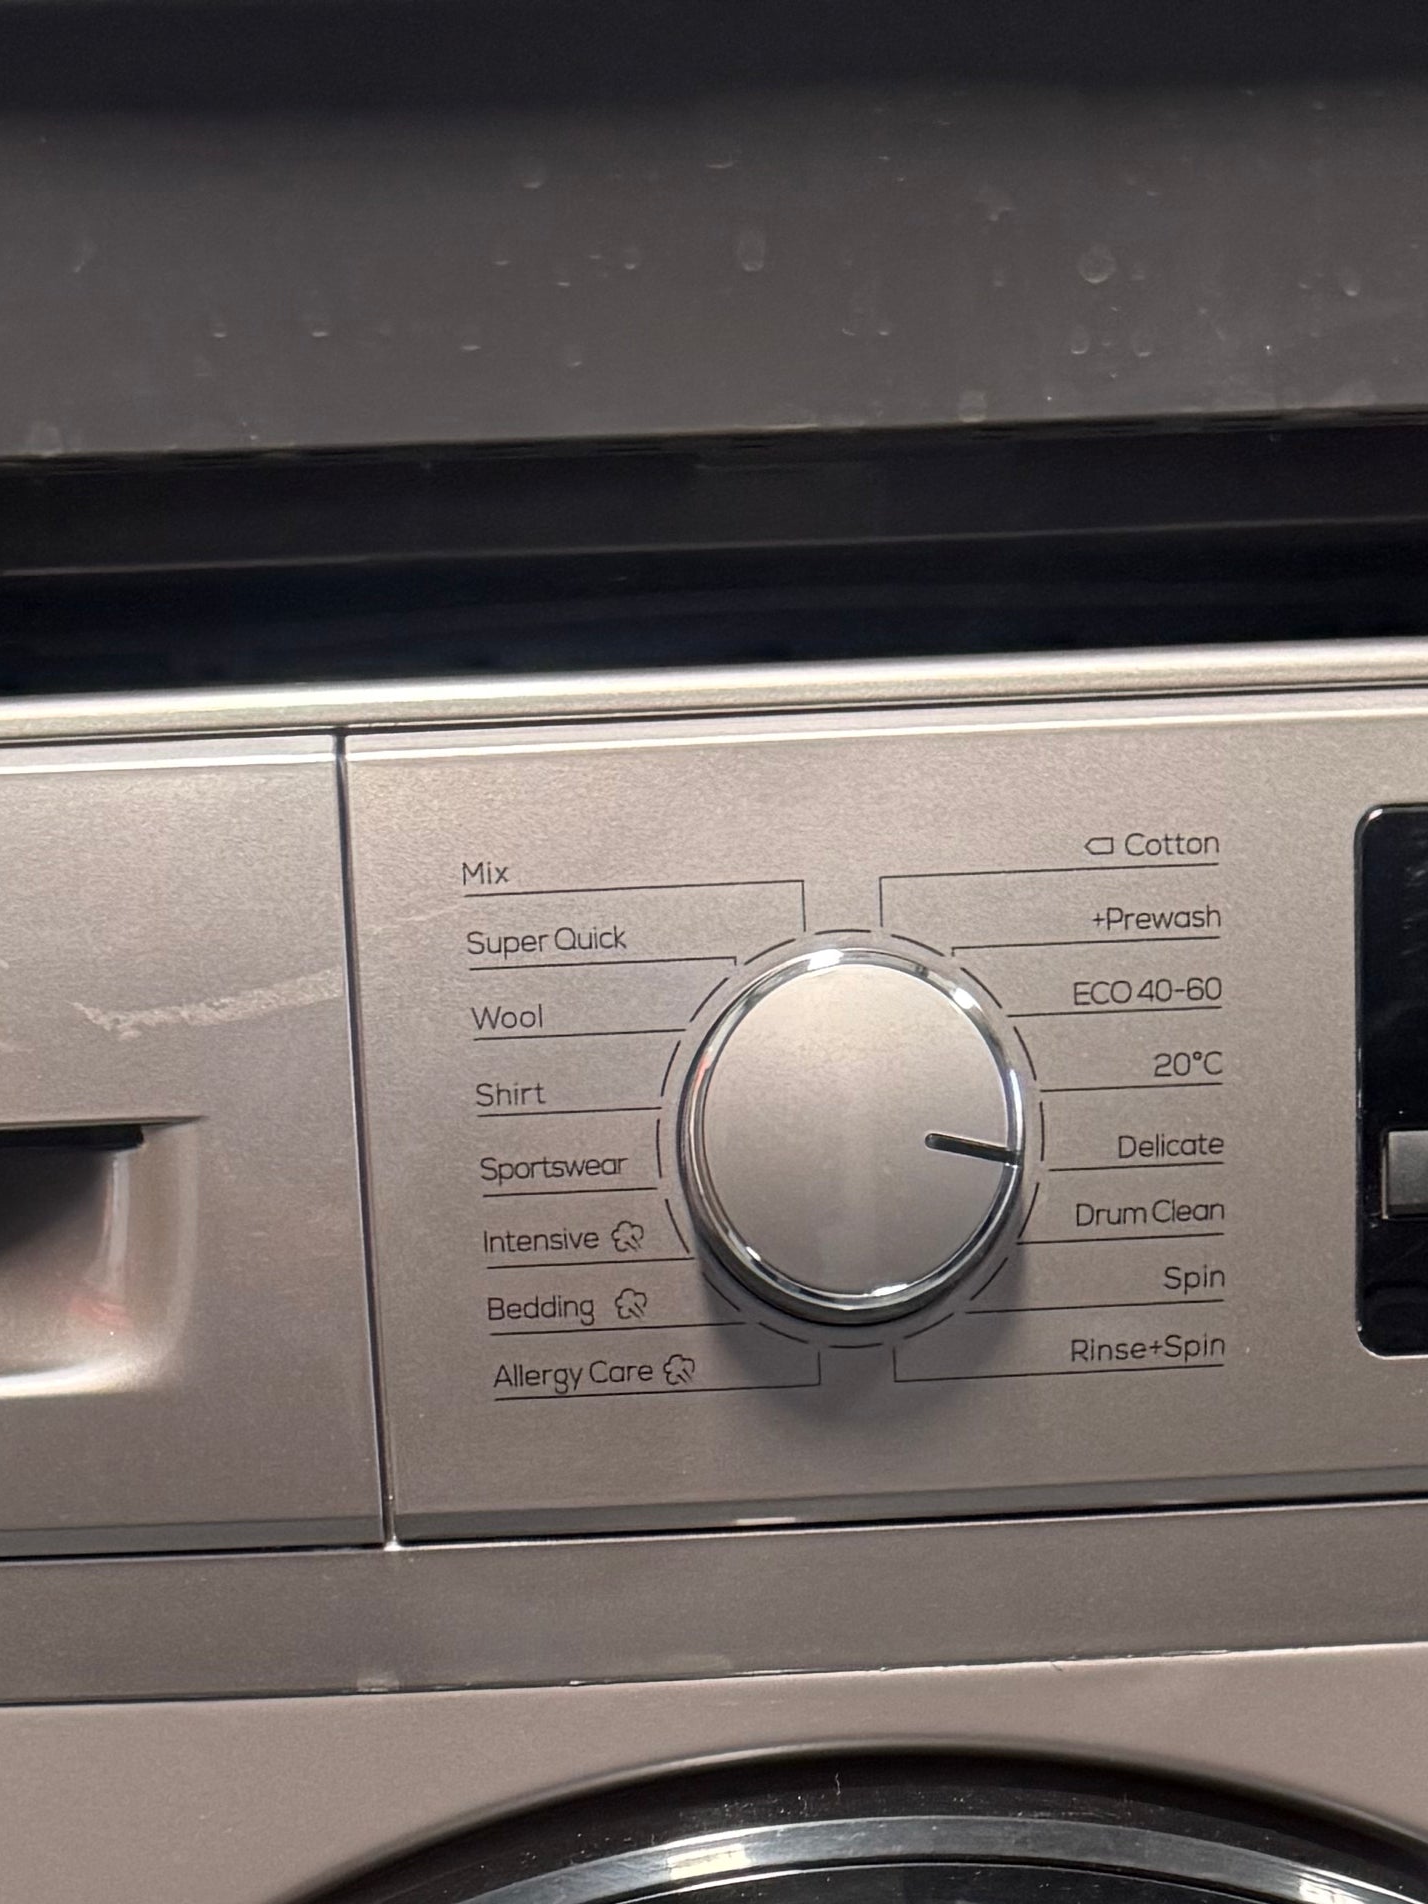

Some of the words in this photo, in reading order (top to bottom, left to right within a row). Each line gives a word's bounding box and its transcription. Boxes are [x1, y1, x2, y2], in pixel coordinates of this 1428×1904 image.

[1125, 833, 1219, 857] Cotton
[462, 862, 508, 885] Mix
[1093, 905, 1221, 930] +Prewash
[467, 929, 549, 959] Super
[555, 925, 627, 951] Quick
[1073, 981, 1131, 1005] ECO
[1137, 977, 1221, 1002] 40-60
[471, 1004, 543, 1030] Wool
[1154, 1051, 1223, 1077] 20°C
[476, 1082, 545, 1107] Shirt
[1118, 1133, 1224, 1159] Delicate
[481, 1156, 628, 1186] Sportswear
[1076, 1203, 1147, 1226] Drum
[1152, 1199, 1225, 1223] Clean
[483, 1229, 599, 1253] Intensive
[1163, 1264, 1225, 1295] Spin
[487, 1295, 594, 1325] Bedding
[1072, 1333, 1225, 1362] Rinse+Spin
[493, 1364, 583, 1394] Allergy
[590, 1360, 653, 1384] Care
